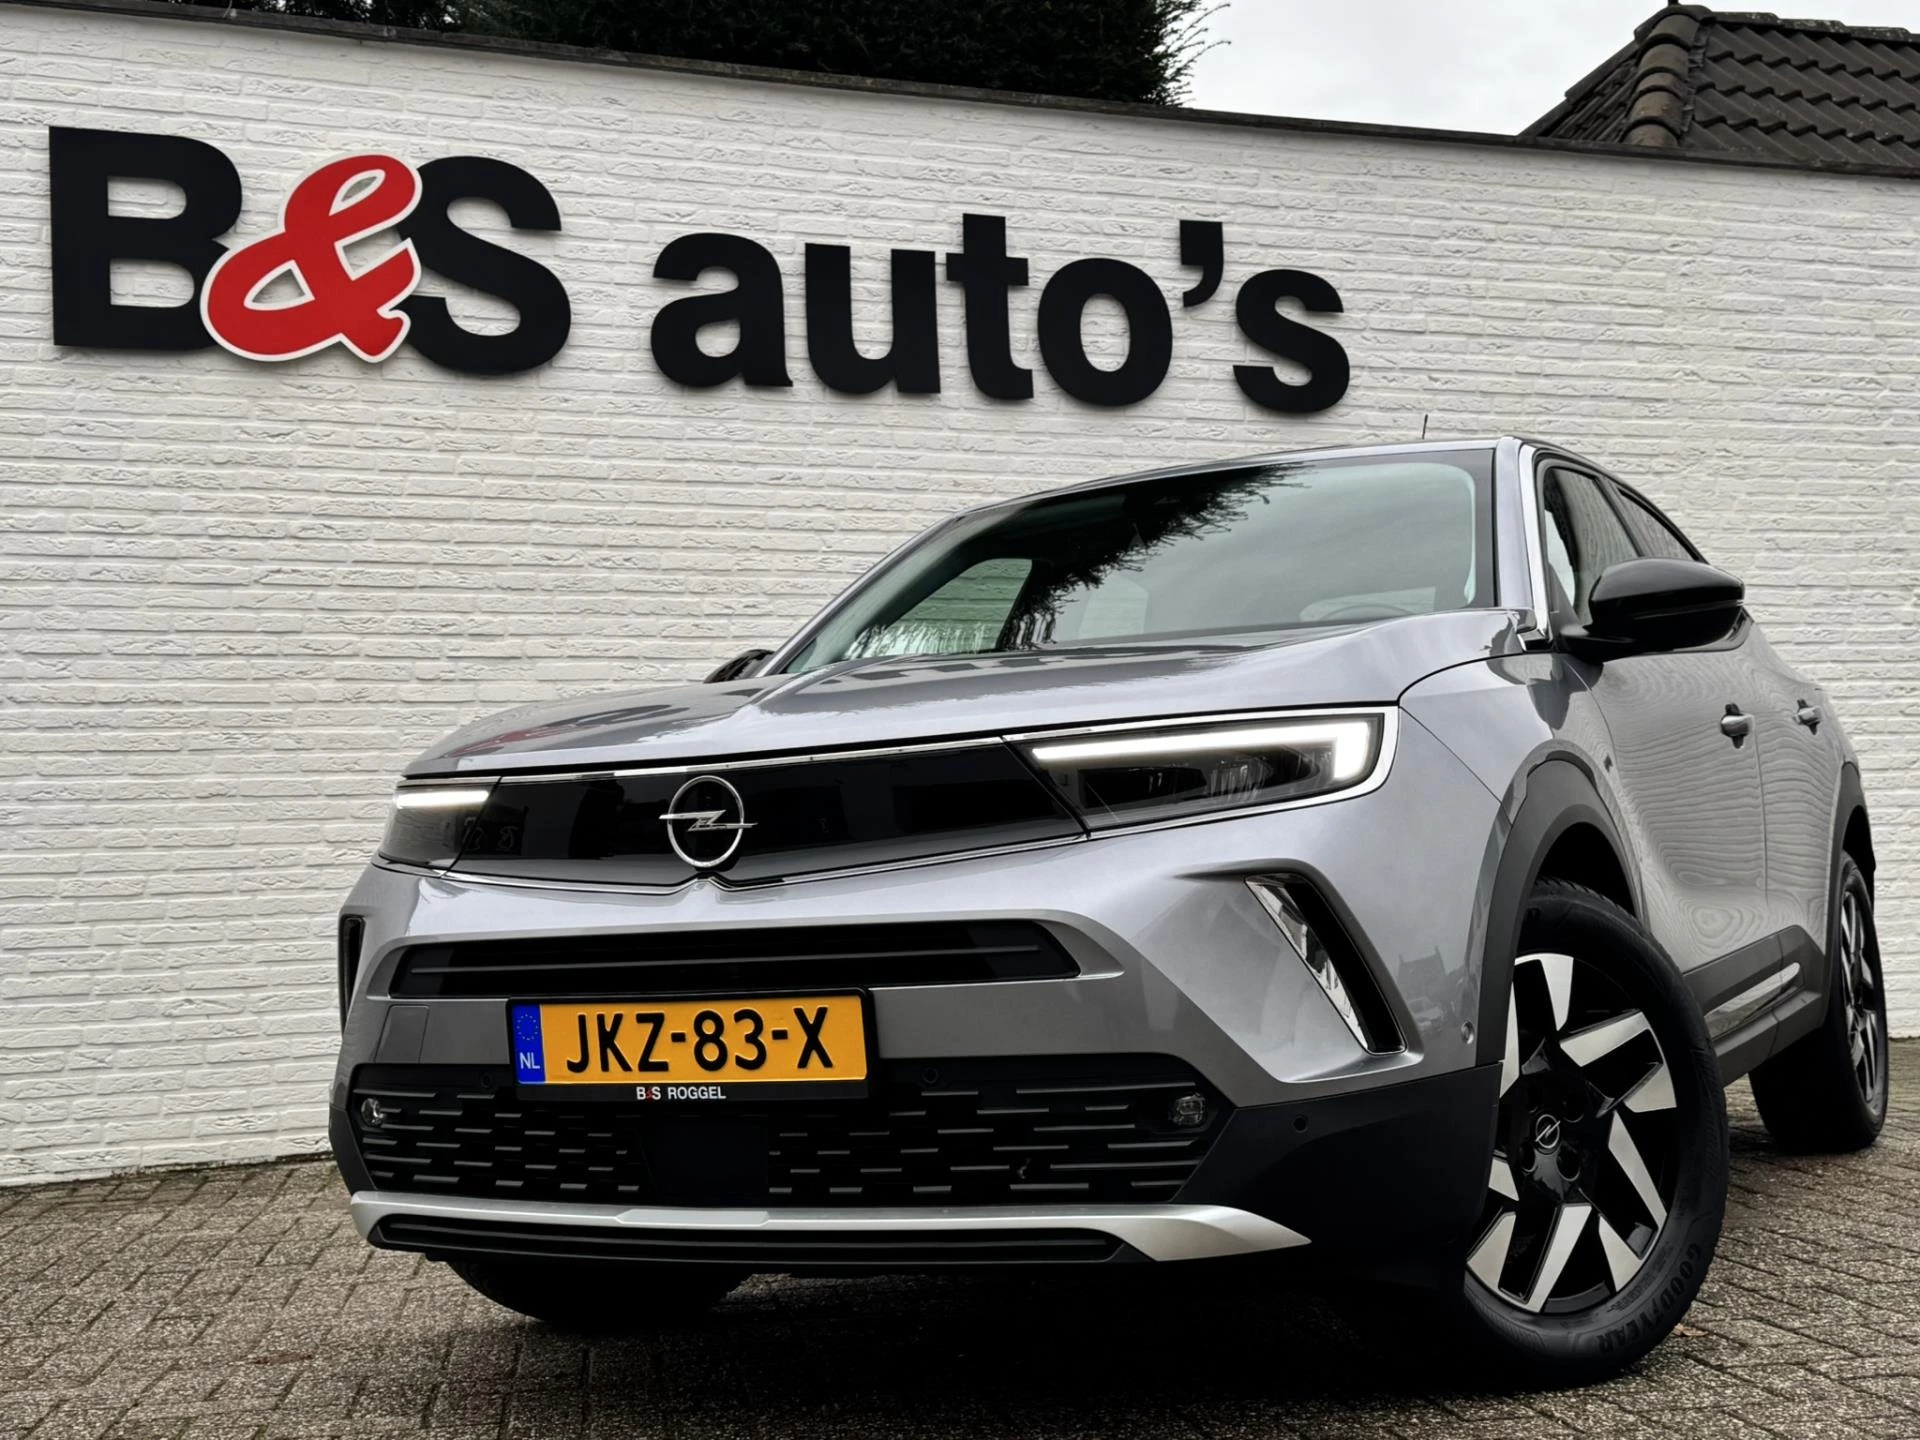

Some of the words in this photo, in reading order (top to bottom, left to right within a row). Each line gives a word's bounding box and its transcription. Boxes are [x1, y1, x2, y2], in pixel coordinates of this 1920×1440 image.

[49, 126, 571, 375] B&S
[651, 213, 1351, 414] auto's
[519, 1052, 541, 1070] NL
[566, 1006, 834, 1073] JKZ-83-X
[667, 1086, 727, 1100] ROGGEL
[1597, 1243, 1701, 1352] GOODYEAR
